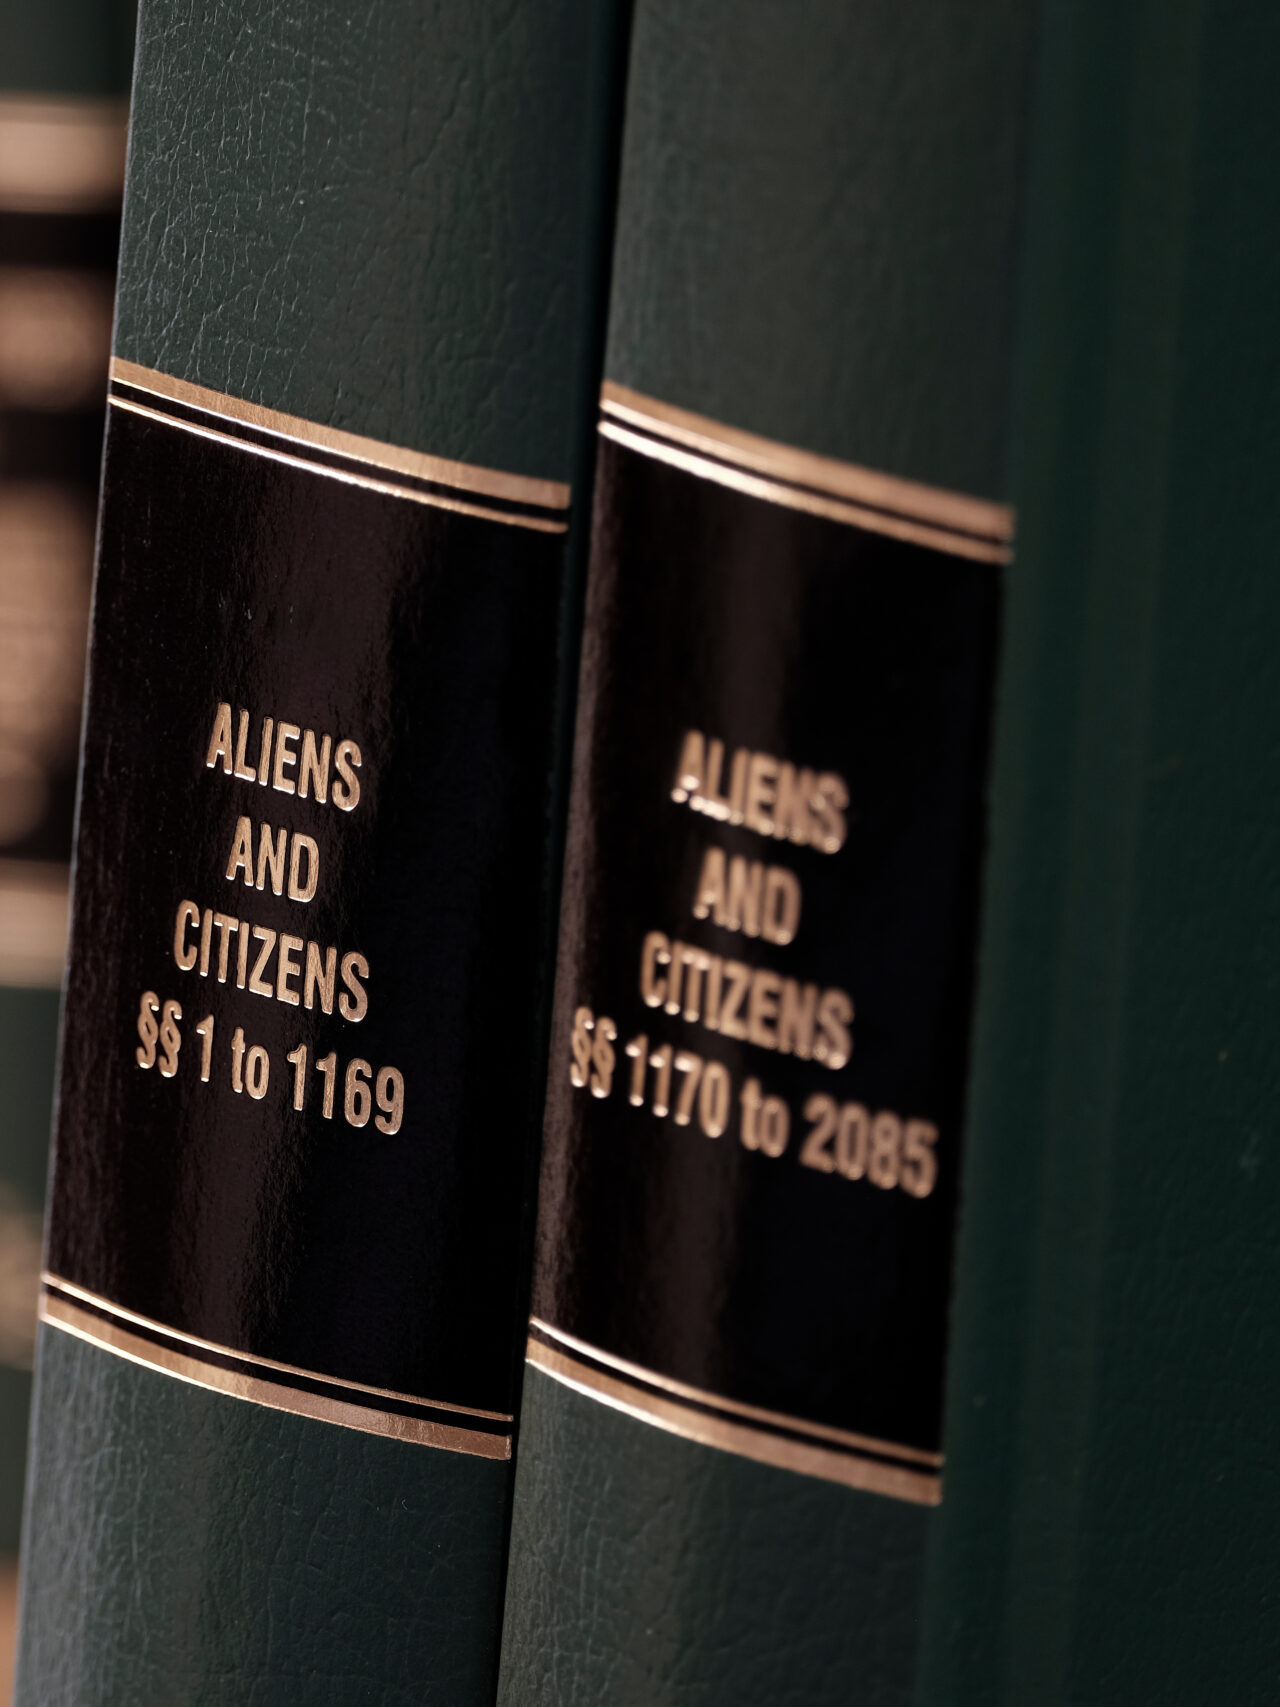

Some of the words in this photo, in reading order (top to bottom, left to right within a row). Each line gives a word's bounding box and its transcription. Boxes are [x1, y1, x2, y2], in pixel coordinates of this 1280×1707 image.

[205, 701, 363, 812] ALIENS
[671, 730, 849, 854] ALIENS
[225, 815, 320, 903] AND
[692, 847, 800, 946] AND
[173, 898, 371, 1024] CITIZENS
[640, 931, 854, 1070] CITIZENS
[135, 990, 183, 1078] §§
[195, 1014, 215, 1083] 1
[231, 1026, 271, 1100] to
[286, 1043, 405, 1136] 1169
[570, 1006, 618, 1099] §§
[625, 1034, 730, 1139] 1170
[740, 1078, 789, 1158] to
[800, 1094, 937, 1198] 2085
